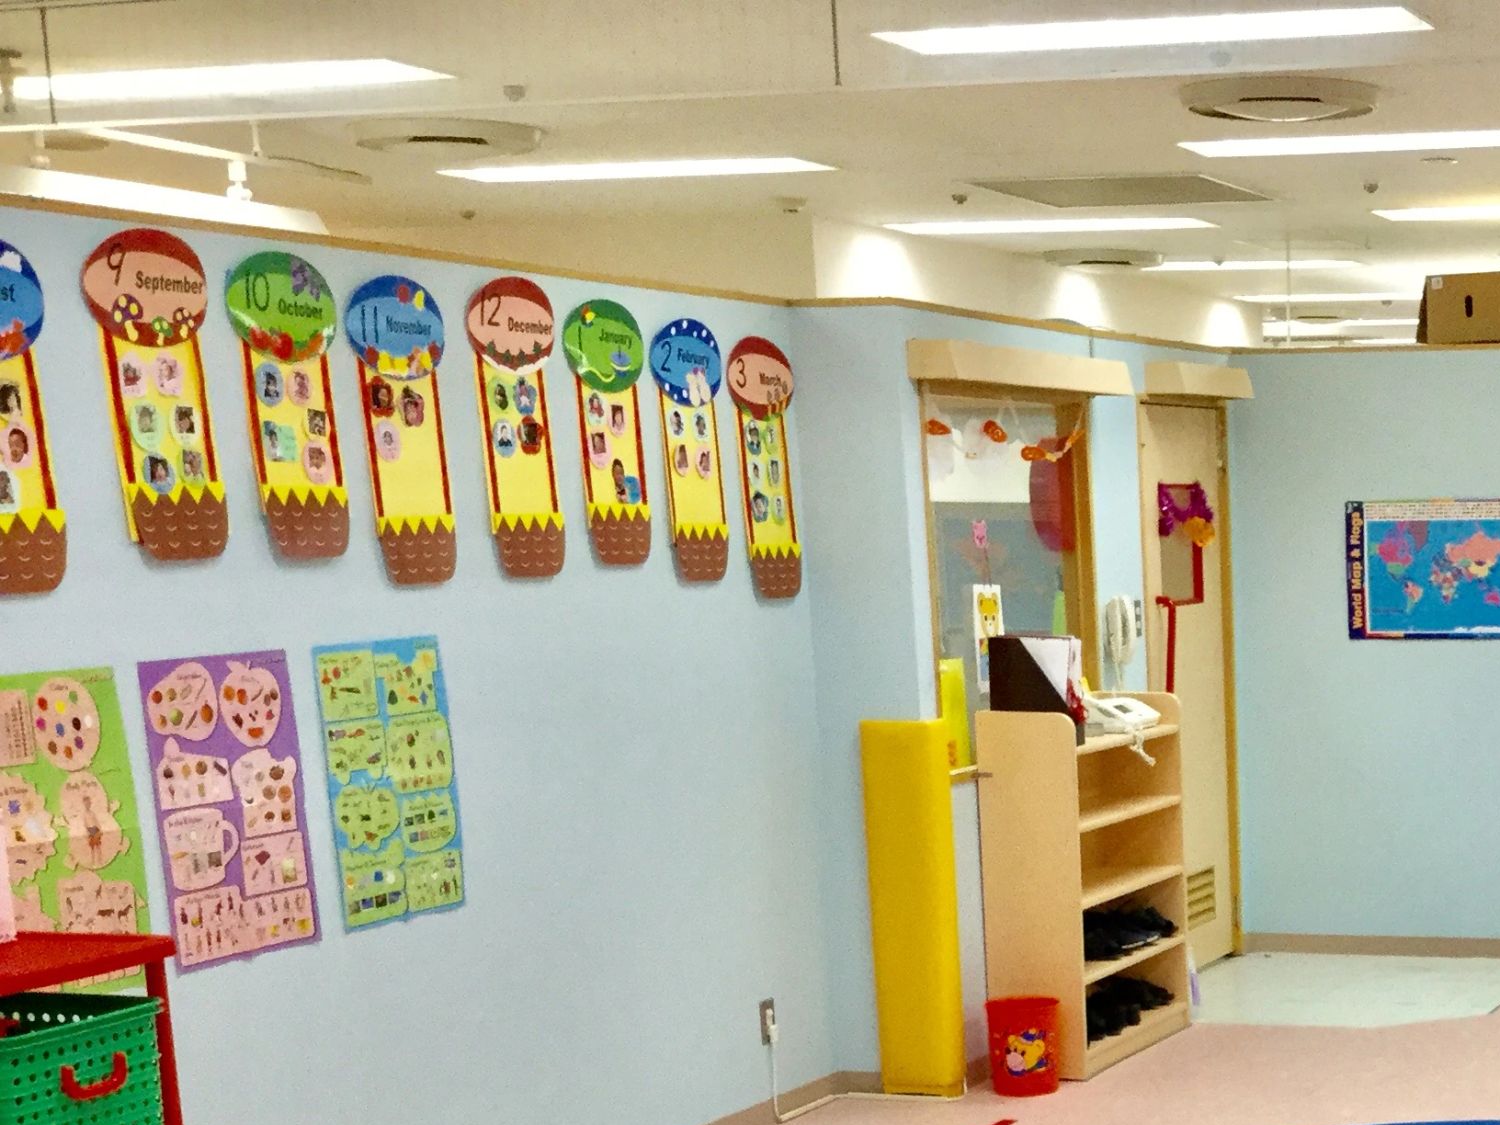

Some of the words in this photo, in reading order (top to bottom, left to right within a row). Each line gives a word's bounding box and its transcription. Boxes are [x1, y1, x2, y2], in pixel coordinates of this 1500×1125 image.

[136, 270, 202, 295] September
[246, 270, 269, 311] 10
[278, 298, 323, 320] October
[361, 305, 379, 344] 11
[386, 315, 432, 336] November
[480, 291, 501, 327] 12
[507, 317, 552, 335] December
[599, 328, 633, 350] January
[660, 341, 672, 373] 2
[677, 348, 710, 369] February
[736, 358, 747, 388] 3
[1351, 511, 1364, 544] Flags
[1351, 562, 1362, 590] Map
[1352, 593, 1364, 629] World
